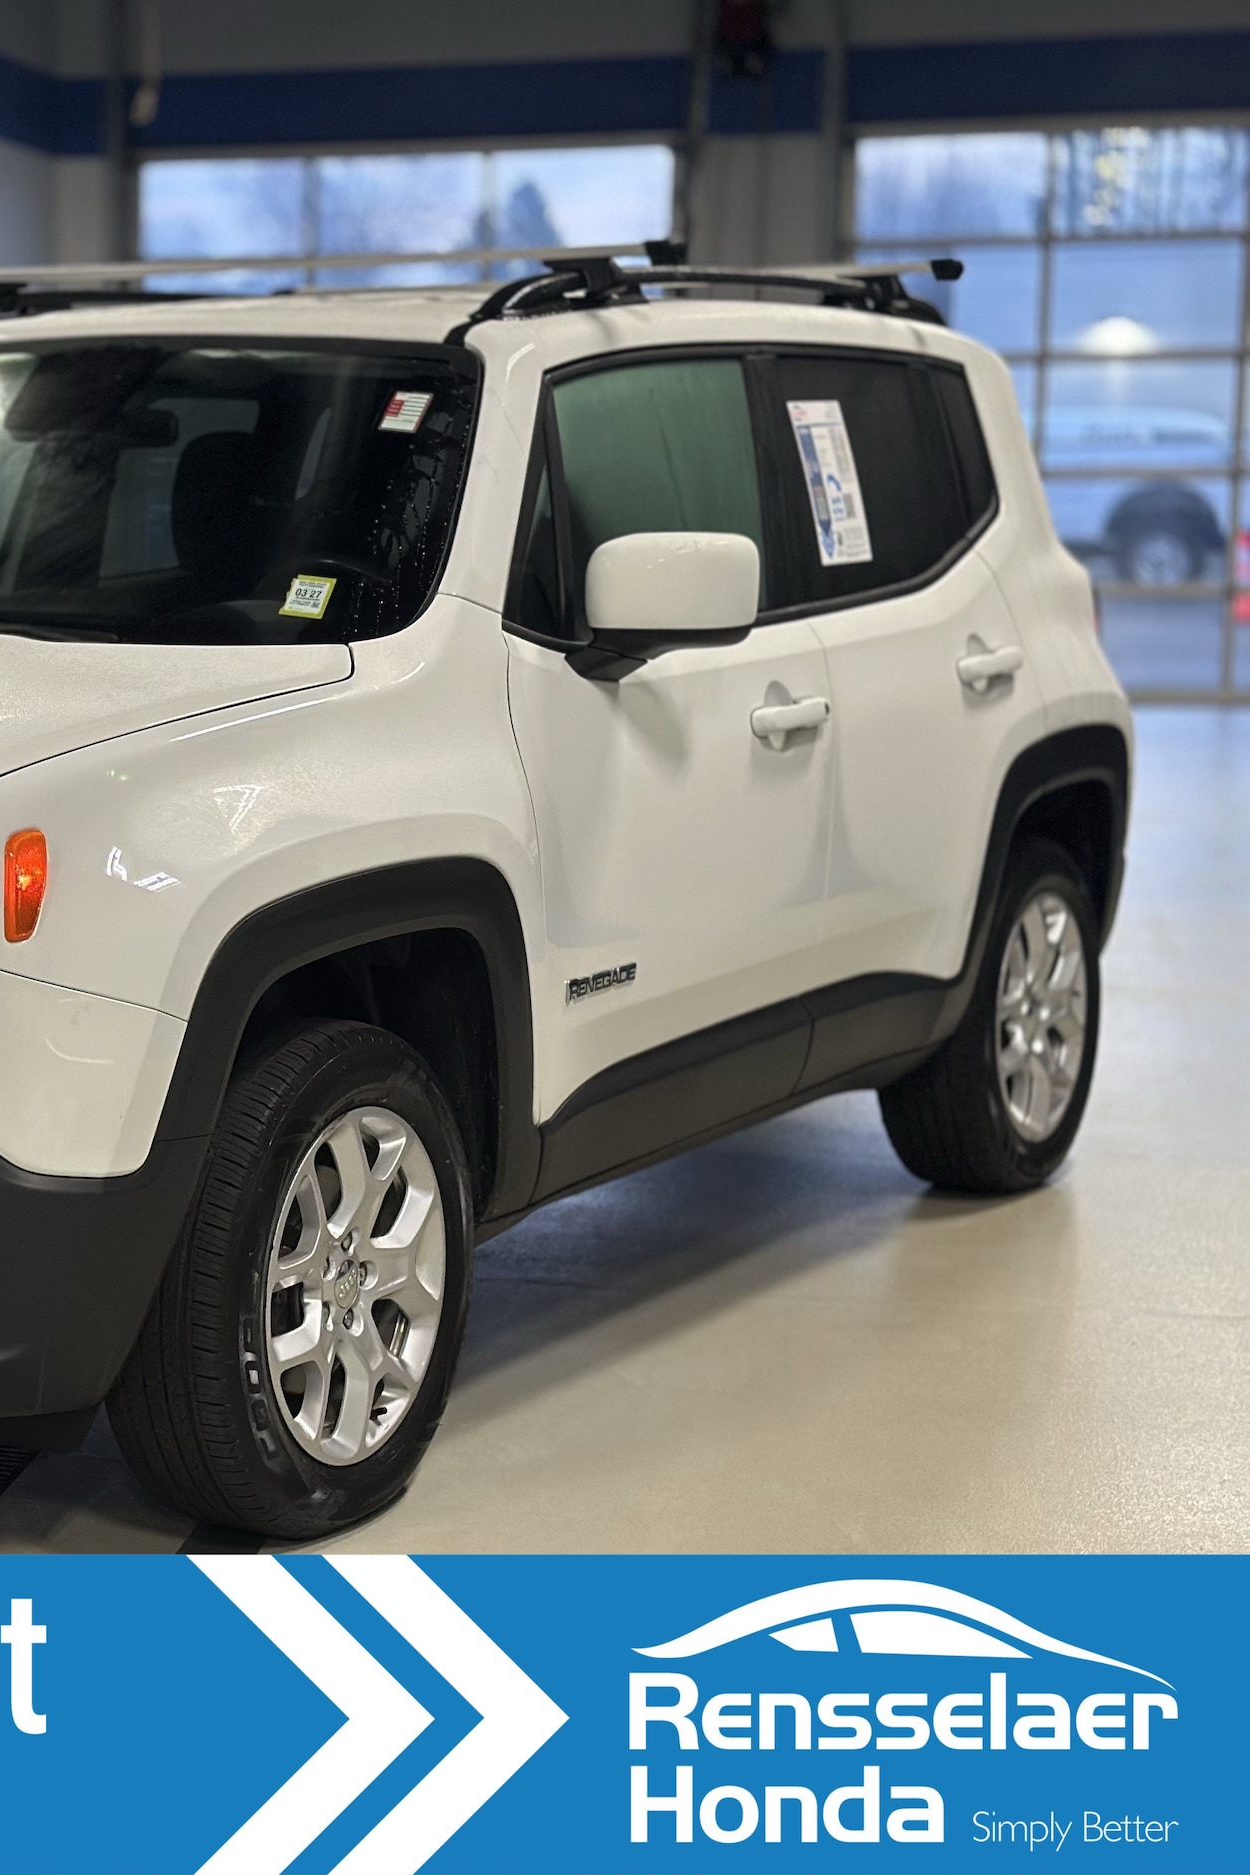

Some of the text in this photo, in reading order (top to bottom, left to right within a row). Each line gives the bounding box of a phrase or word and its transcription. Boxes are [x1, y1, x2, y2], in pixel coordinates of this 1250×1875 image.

[295, 588, 308, 597] 03
[309, 590, 323, 599] 27
[564, 962, 637, 1006] RENEGADE
